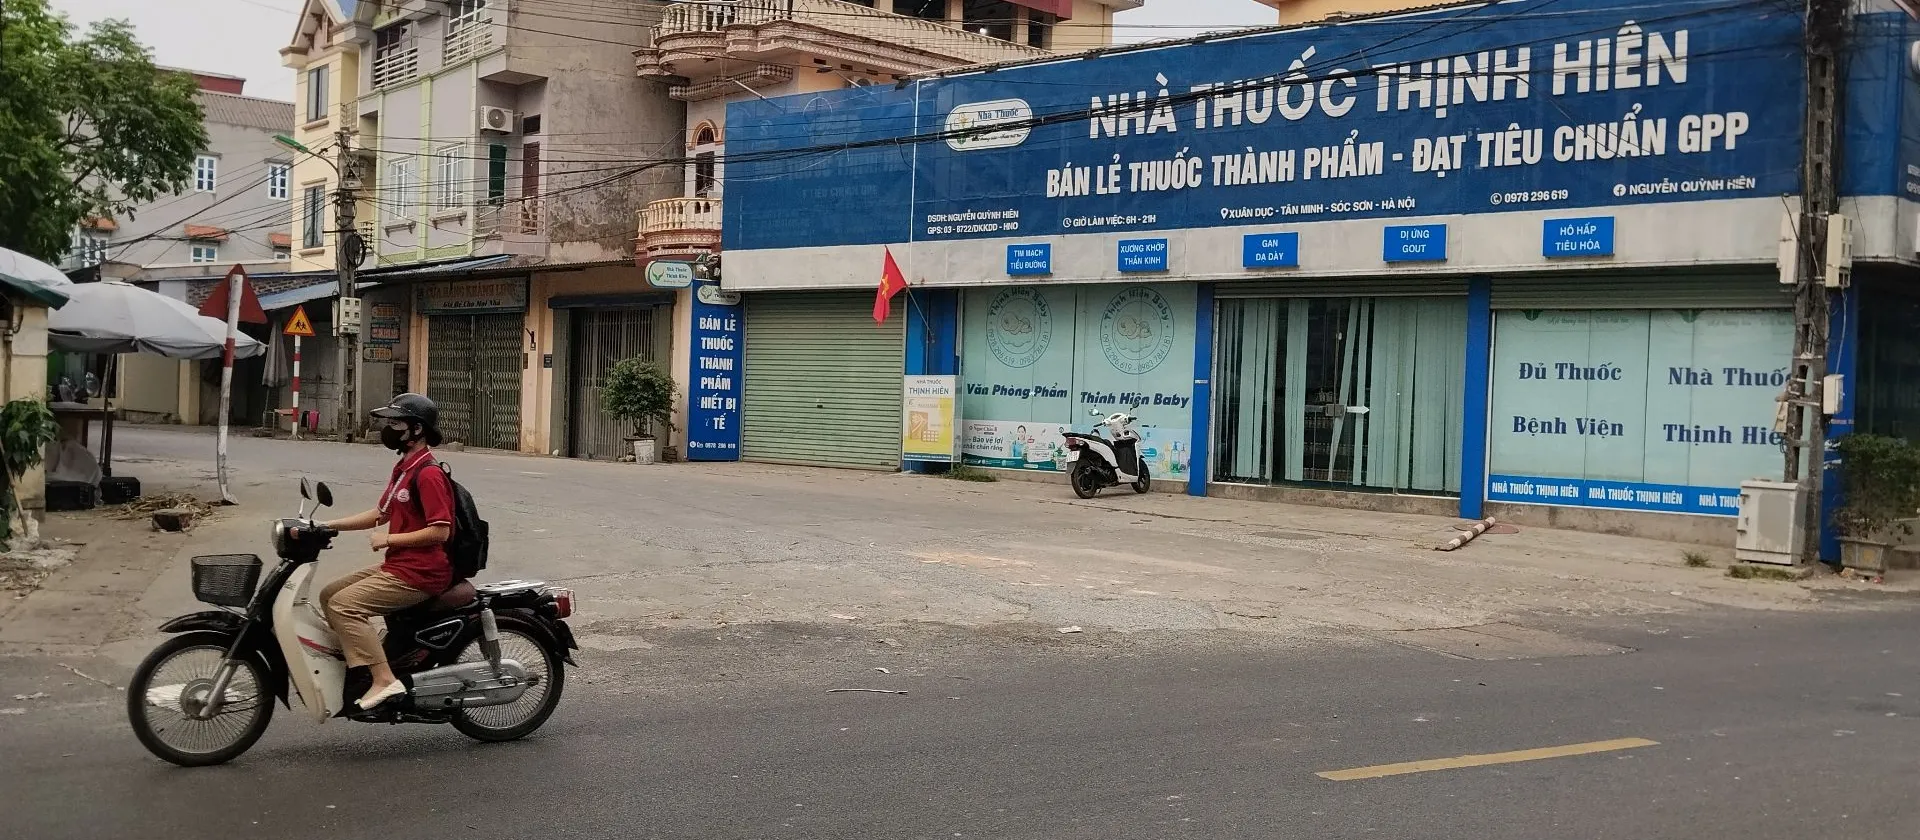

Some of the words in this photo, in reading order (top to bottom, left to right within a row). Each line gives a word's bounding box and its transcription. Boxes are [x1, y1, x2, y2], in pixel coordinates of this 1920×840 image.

[1090, 72, 1176, 139] NHÀ
[1195, 46, 1357, 129] THUỐC
[1373, 47, 1530, 118] THỊNH
[1553, 20, 1688, 96] HIÊN
[978, 110, 992, 120] Nhà
[996, 107, 1018, 118] Thuốc
[1047, 163, 1090, 198] BÁN
[1096, 154, 1120, 194] LẺ
[1130, 146, 1202, 192] THUỐC
[1212, 146, 1295, 186] THÀNH
[1304, 130, 1384, 179] PHẨM
[1412, 134, 1466, 178] ĐẠT
[1478, 123, 1542, 168] TIÊU
[1554, 102, 1666, 162] CHUẨN
[1679, 111, 1749, 154] GPP
[1629, 178, 1678, 195] NGUYỄN
[1681, 178, 1724, 191] QUỲNH
[1727, 175, 1756, 190] HIÊN
[1504, 191, 1528, 203] 0978
[1530, 190, 1550, 202] 296
[1551, 190, 1568, 200] 619
[976, 210, 1001, 220] QUỲNH
[1228, 207, 1253, 219] XUÂN
[1254, 208, 1274, 220] DỤC
[1280, 204, 1299, 215] TÂN
[1300, 204, 1323, 214] MINH
[1331, 200, 1350, 213] SÓC
[1352, 201, 1373, 211] SƠN
[1381, 198, 1396, 210] HÀ
[1397, 196, 1415, 210] NỘI
[1073, 216, 1087, 227] GIỜ
[1088, 216, 1104, 226] LÀM
[1106, 214, 1125, 227] VIỆC:
[1126, 216, 1136, 224] 6H
[1560, 225, 1574, 236] HÔ
[1576, 222, 1597, 235] HẤP
[928, 227, 943, 235] GPS:
[1400, 230, 1409, 241] DỊ
[1411, 228, 1429, 239] ỨNG
[1262, 239, 1278, 248] GAN
[1402, 244, 1426, 253] GOUT
[1555, 241, 1577, 251] TIÊU
[1579, 240, 1600, 250] HÓA
[1144, 257, 1161, 265] KINH
[1255, 252, 1266, 262] DẠ
[1269, 251, 1284, 261] DÀY
[700, 314, 720, 331] BÁN
[724, 313, 736, 331] LẺ
[701, 334, 734, 351] THUỐC
[700, 354, 733, 371] THÀNH
[1519, 363, 1547, 380] Đủ
[1554, 362, 1622, 380] Thuốc
[1668, 367, 1713, 385] Nhà
[966, 383, 989, 396] Văn
[992, 384, 1030, 399] Phòng
[1033, 382, 1068, 398] Phẩm
[697, 393, 724, 409] HIẾT
[726, 398, 736, 412] BỊ
[1080, 391, 1116, 407] Thịnh
[1119, 392, 1149, 405] Hiên
[1153, 393, 1190, 408] Baby
[713, 413, 726, 430] TẾ
[1512, 416, 1567, 436] Bệnh
[1576, 417, 1624, 438] Viện
[1663, 424, 1732, 446] Thịnh
[1491, 481, 1508, 494] NHÀ
[1509, 481, 1534, 495] THUỐC
[1536, 484, 1558, 498] THỊNH
[1560, 484, 1579, 498] HIÊN
[1588, 486, 1606, 499] NHÀ
[1607, 486, 1634, 501] THUỐC
[1636, 490, 1660, 505] THỊNH
[1662, 490, 1683, 505] HIÊN
[1699, 492, 1718, 507] NHÀ
